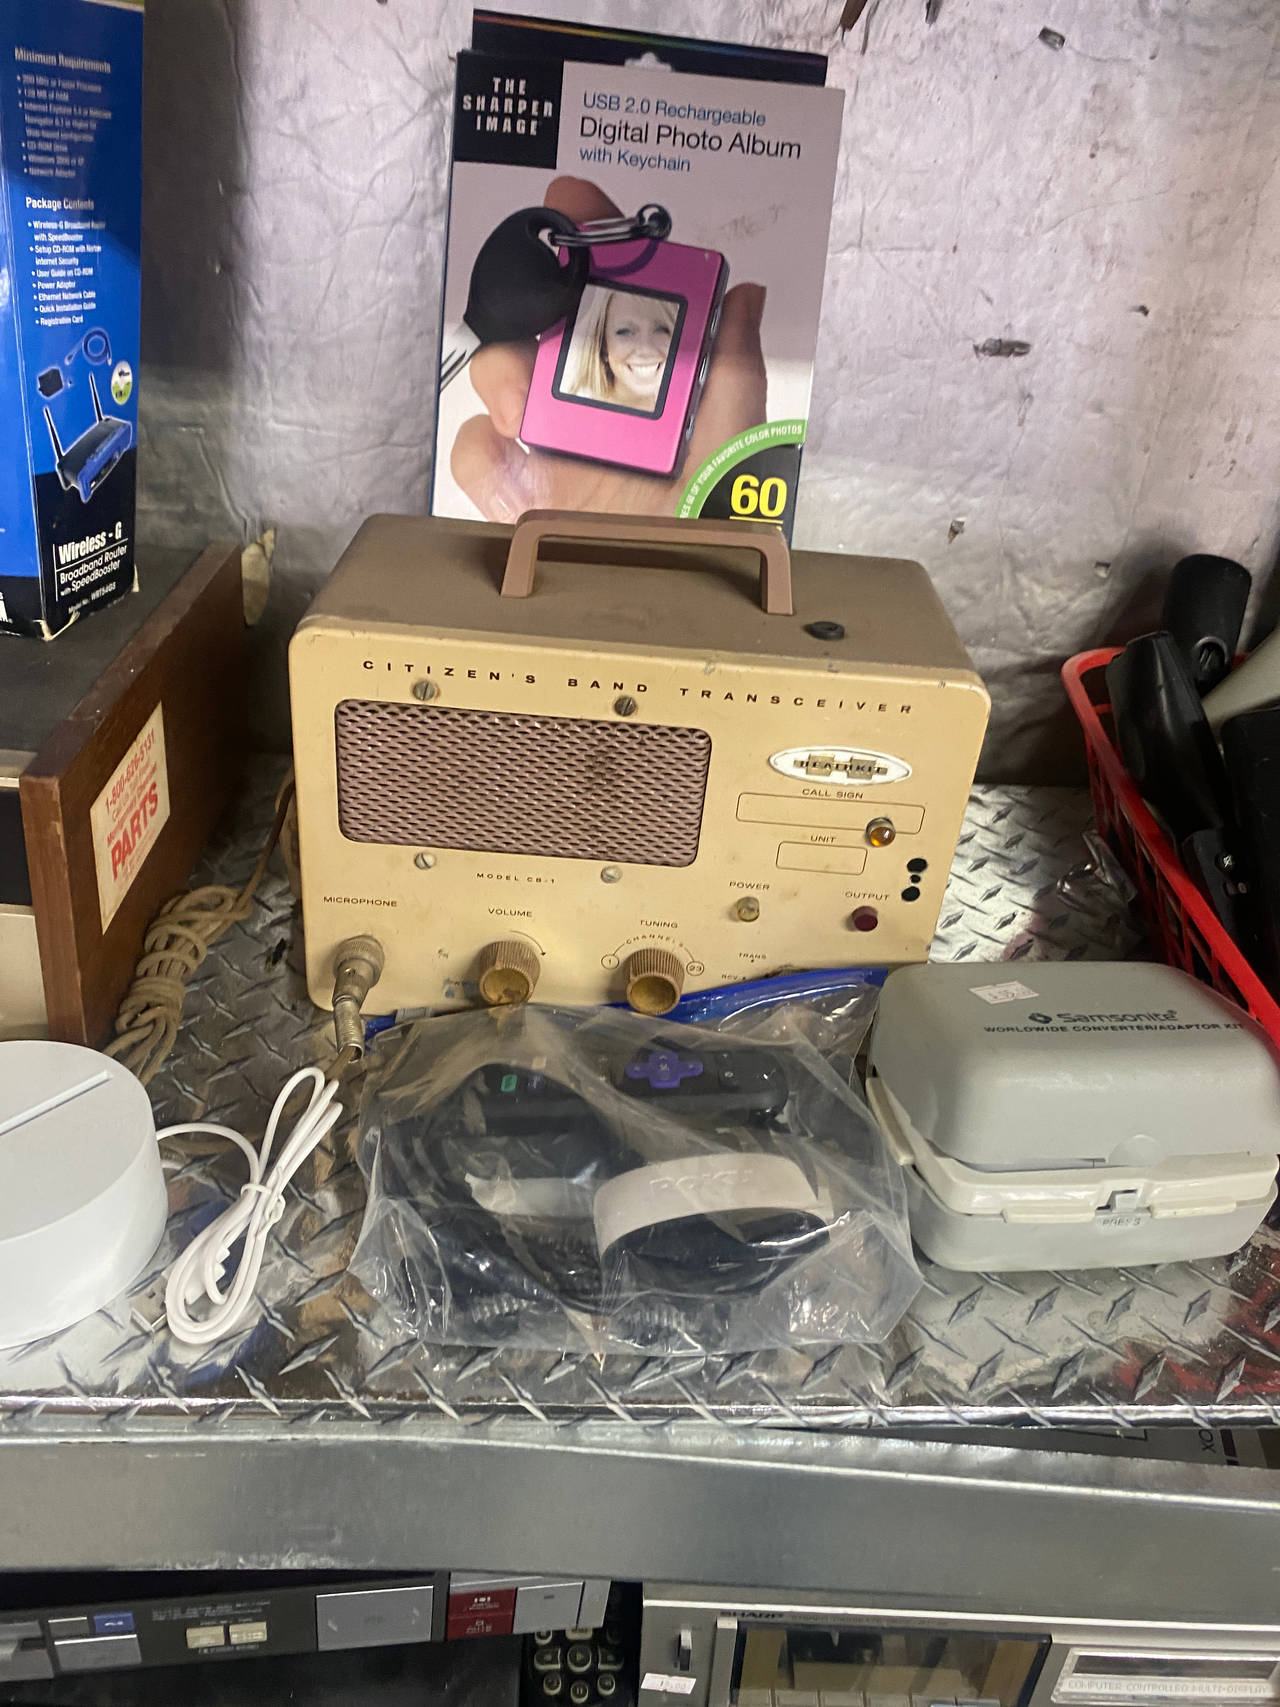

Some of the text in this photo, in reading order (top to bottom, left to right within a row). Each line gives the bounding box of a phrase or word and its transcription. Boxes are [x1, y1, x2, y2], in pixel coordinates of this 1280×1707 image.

[15, 47, 57, 66] Minimum
[493, 77, 526, 96] THE
[462, 94, 553, 118] SHARPER
[583, 91, 767, 127] USB 2.0 Rechargeable
[476, 115, 538, 136] IMAGE
[580, 116, 801, 160] Digital Photo Album
[580, 147, 691, 172] with Keychain
[26, 197, 94, 212] Package Contents
[35, 244, 51, 255] Setup
[52, 244, 75, 253] CD-ROM
[35, 256, 58, 265] Internet
[36, 269, 50, 278] User
[38, 281, 56, 289] Power
[39, 292, 61, 301] Ethernet
[40, 304, 55, 313] Quick
[71, 315, 83, 323] Card
[698, 463, 715, 485] YOUR
[711, 437, 746, 469] FAVORITE
[744, 428, 770, 444] COLOR
[770, 424, 803, 437] PHOTOS
[731, 474, 787, 517] 60
[58, 531, 107, 565] Wireless
[115, 521, 122, 540] G
[60, 545, 127, 585] Broadband Router
[71, 560, 120, 593] SpeedBooster
[362, 660, 911, 714] CITIZEN'S BAND TRANSCEIVER
[799, 759, 887, 775] HEATHKIT
[802, 788, 864, 799] CALL SIGN
[111, 781, 158, 881] PARTS
[810, 835, 836, 843] UNIT
[476, 872, 556, 884] MODEL CB-1
[729, 880, 770, 890] POWER
[323, 896, 397, 908] MICROPHONE
[845, 891, 889, 901] OUTPUT
[487, 907, 533, 918] VOLUME
[640, 919, 679, 929] TUNING
[626, 933, 684, 948] CHANNELS
[689, 964, 702, 972] 23
[983, 1022, 1244, 1034] WORLDWIDE CONVERTER/ADAPTOR KIT
[720, 1610, 783, 1618] SHARP
